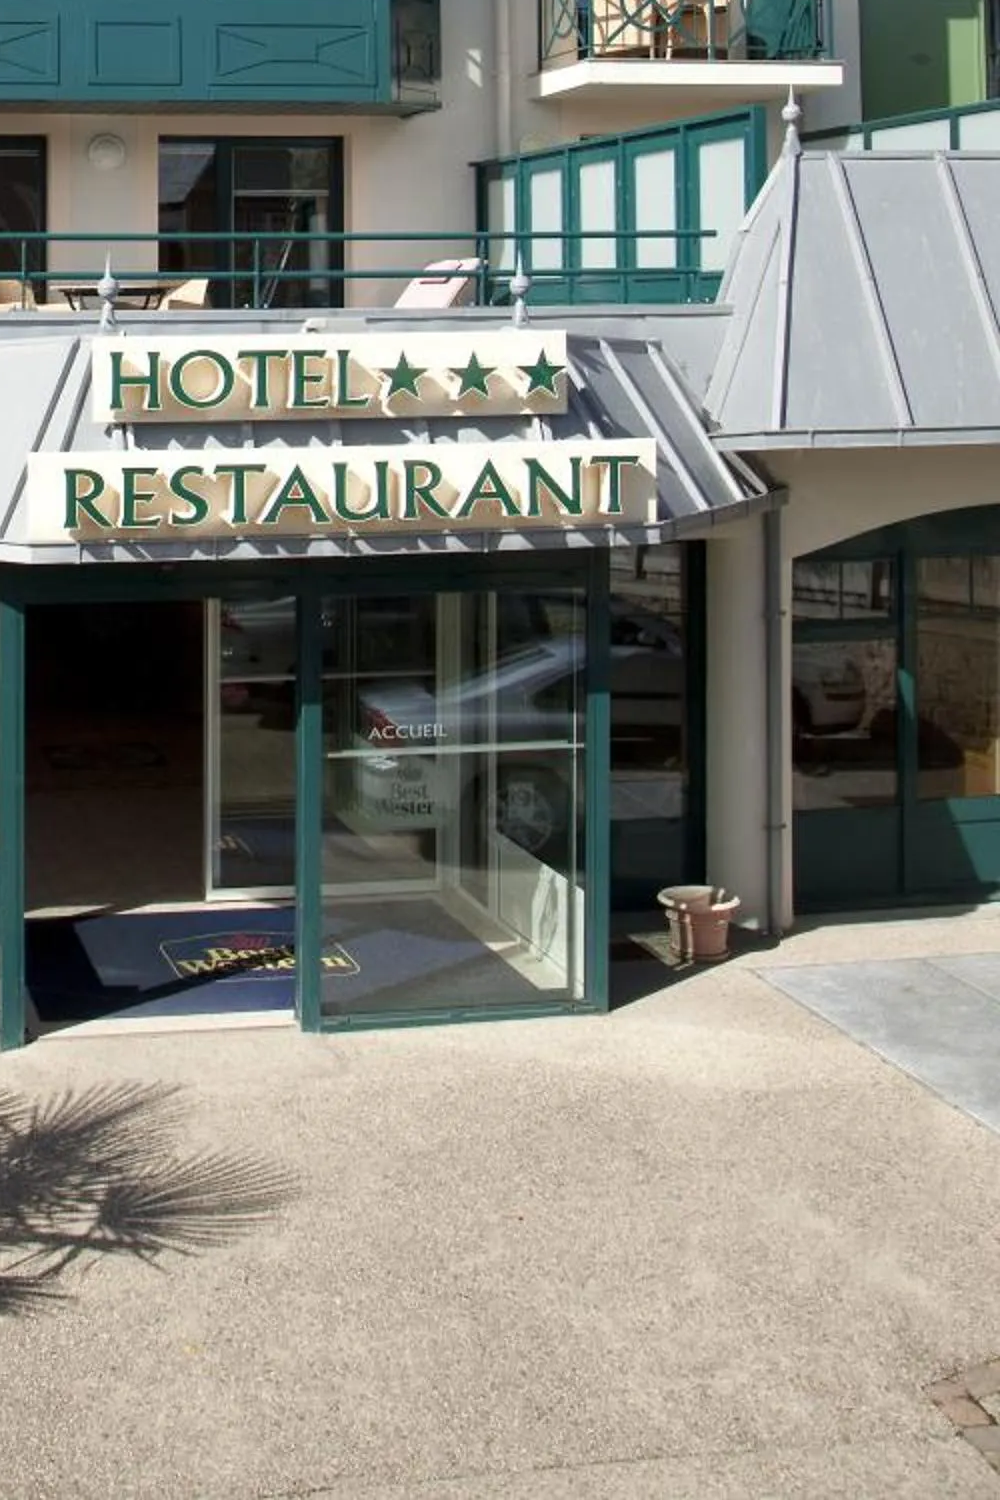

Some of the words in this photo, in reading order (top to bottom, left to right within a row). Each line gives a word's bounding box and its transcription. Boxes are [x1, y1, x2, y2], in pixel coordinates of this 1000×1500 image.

[109, 349, 370, 411] HOTEL
[64, 454, 640, 530] RESTAURANT
[368, 724, 448, 740] ACCUEIL
[375, 799, 447, 816] Wester
